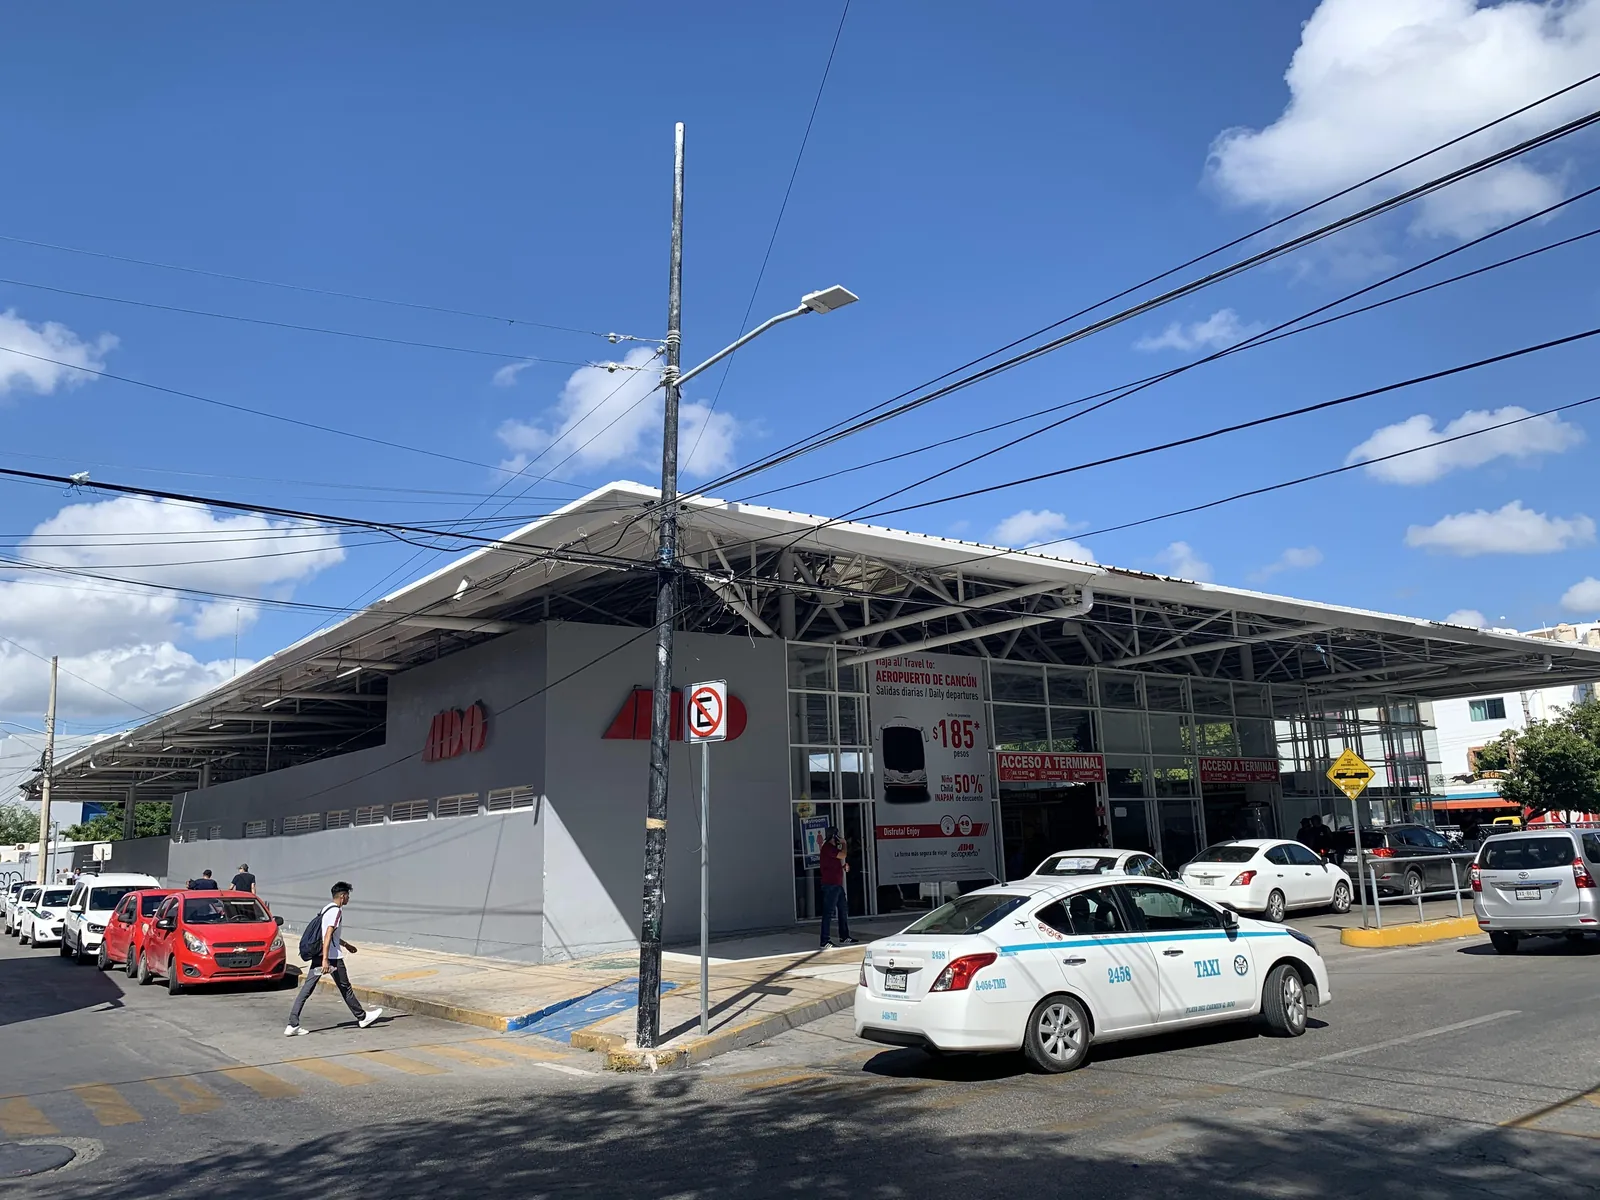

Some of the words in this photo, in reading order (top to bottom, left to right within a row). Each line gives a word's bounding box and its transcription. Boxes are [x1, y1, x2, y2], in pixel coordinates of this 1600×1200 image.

[904, 657, 925, 669] Travel
[926, 659, 936, 669] to:
[876, 670, 931, 685] AEROPUERTO
[932, 673, 943, 686] DE
[945, 673, 977, 687] CANCÚN
[875, 685, 900, 697] Salidas
[901, 686, 924, 698] diarias
[929, 687, 945, 701] Daily
[946, 688, 979, 701] departures
[697, 696, 714, 728] E
[421, 704, 489, 762] ADO
[953, 750, 970, 759] pesos
[1001, 755, 1042, 769] ACCESO
[1044, 756, 1052, 769] A
[1053, 756, 1102, 770] TERMINAL
[1201, 759, 1232, 771] ACCESO
[1234, 760, 1240, 771] A
[1240, 761, 1277, 772] TERMINAL
[934, 793, 955, 802] INAPAM
[956, 794, 962, 802] de
[962, 794, 984, 802] descuento
[906, 826, 921, 837] Enjoy
[894, 850, 899, 858] La
[919, 850, 932, 858] segura
[931, 950, 946, 960] 2458
[1107, 965, 1132, 984] 2458
[1194, 959, 1221, 978] TAXI
[976, 978, 1006, 990] A-056-TMR
